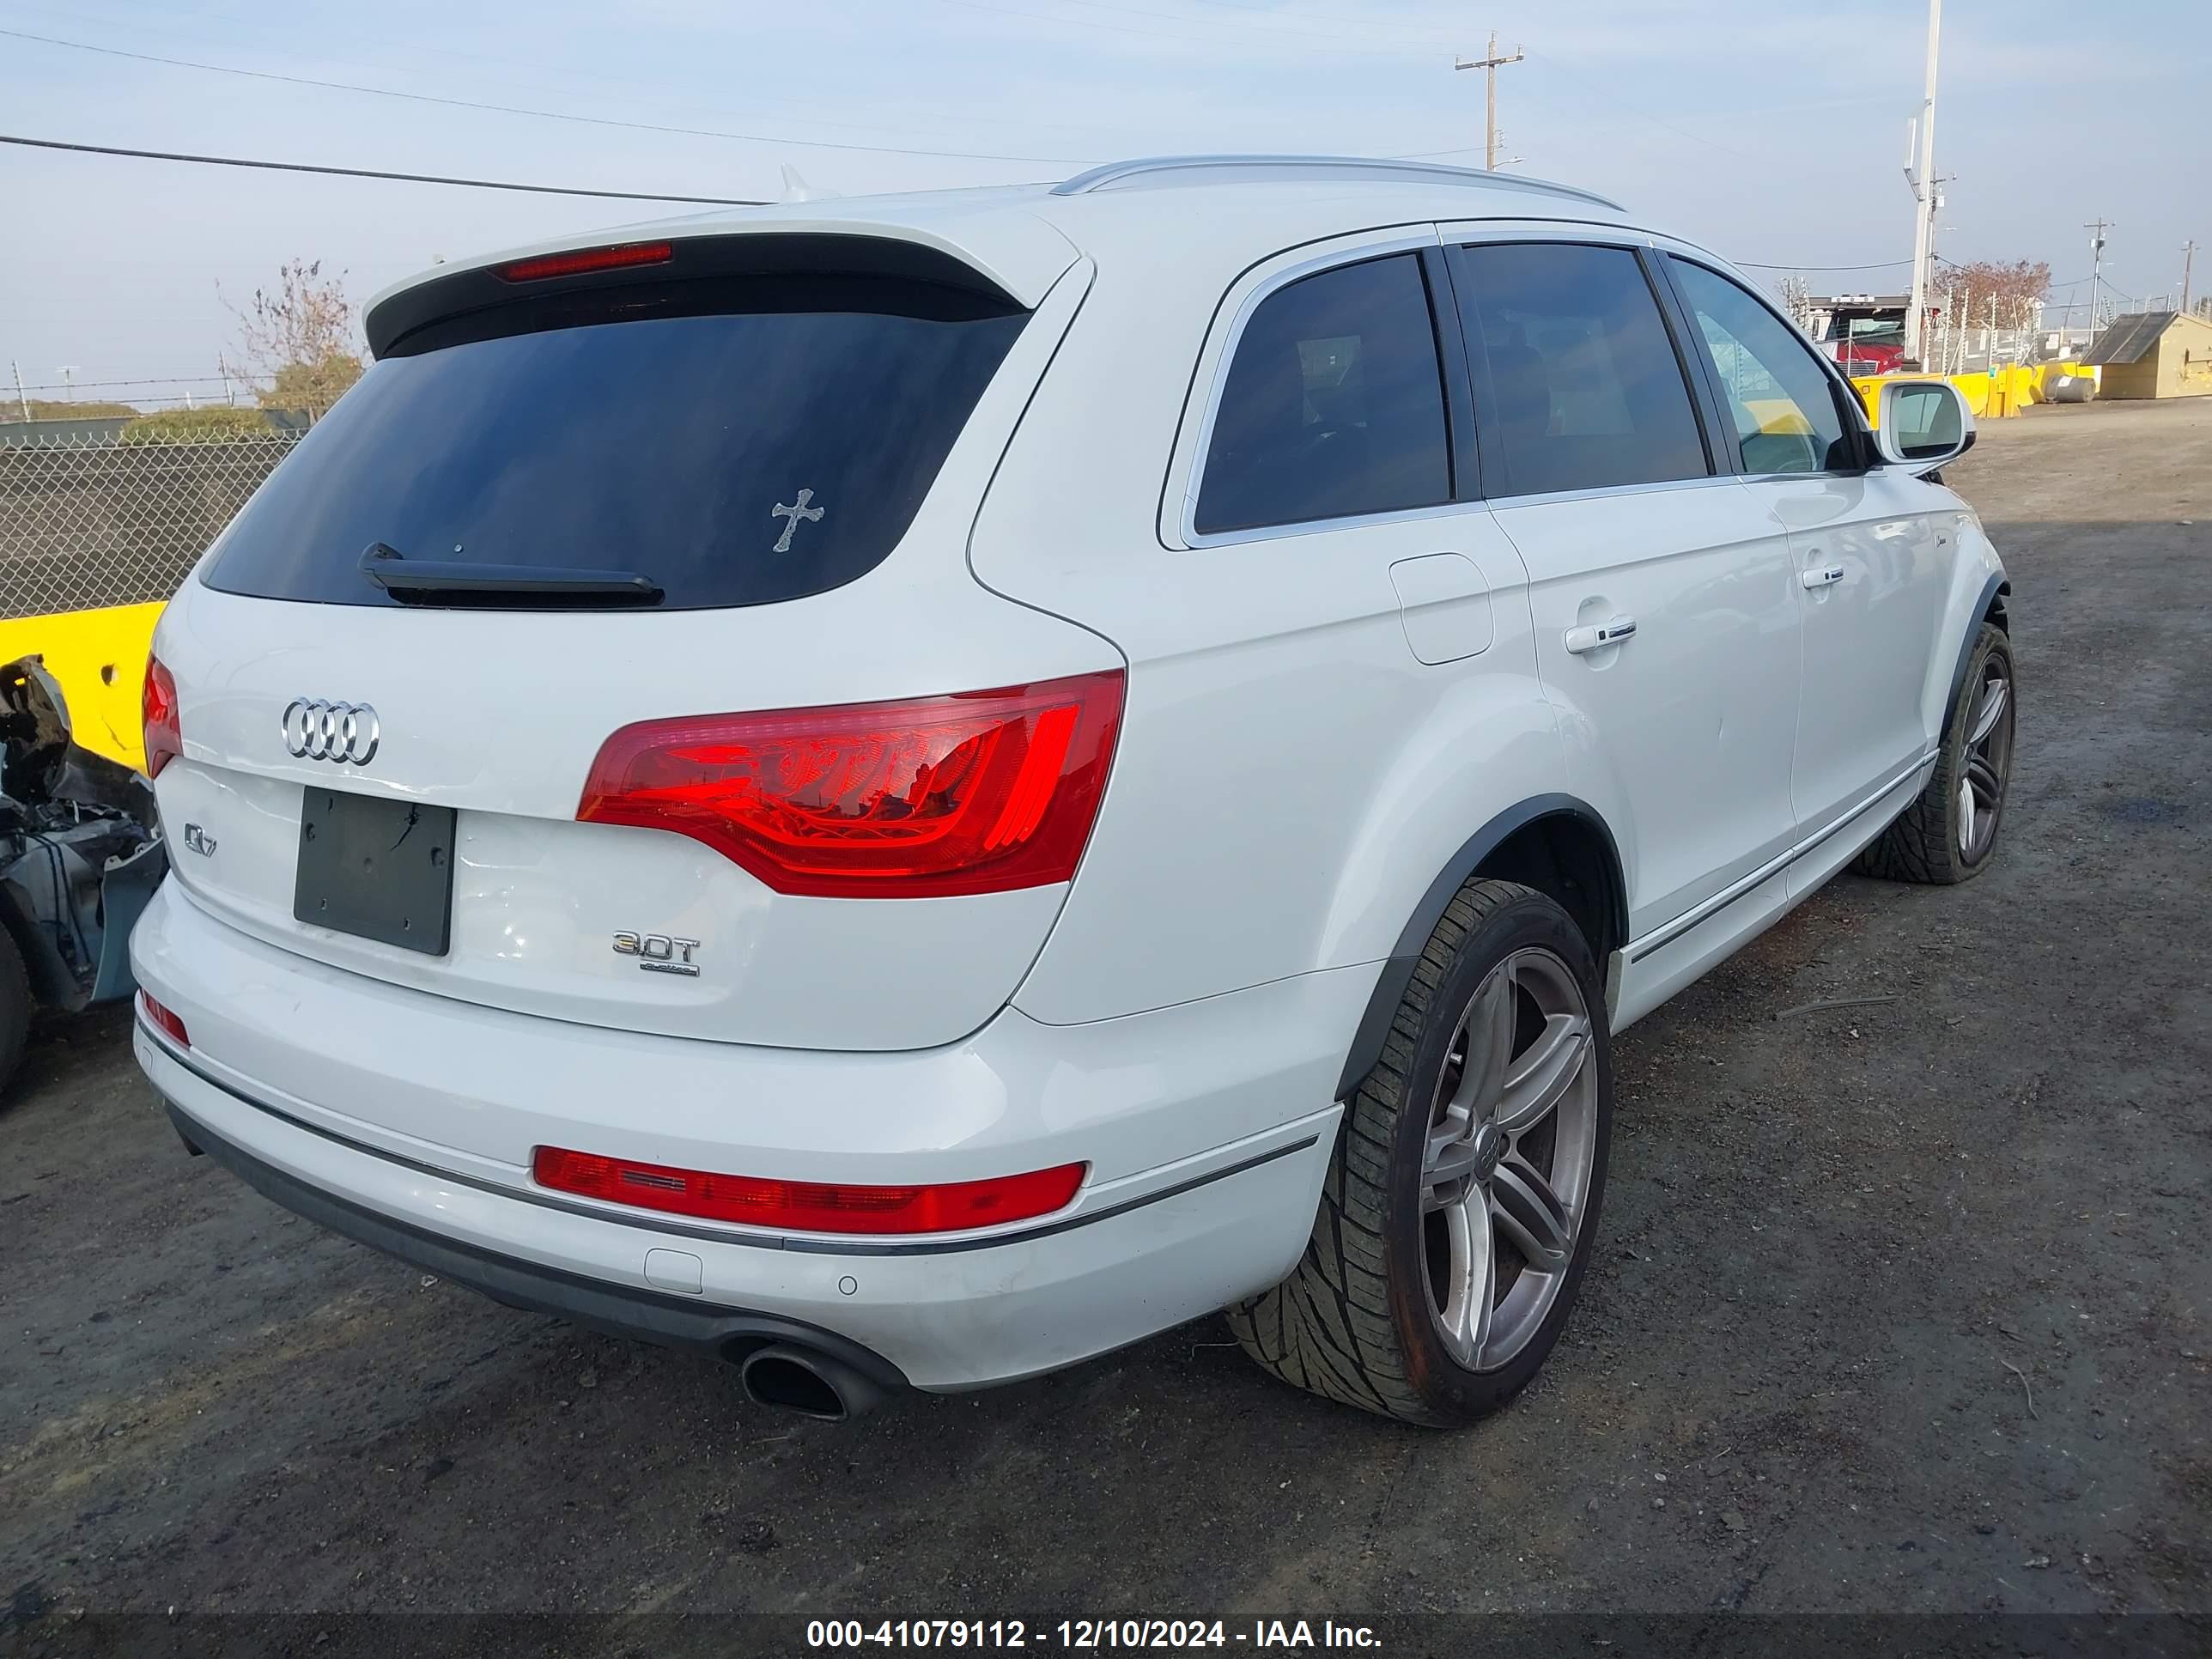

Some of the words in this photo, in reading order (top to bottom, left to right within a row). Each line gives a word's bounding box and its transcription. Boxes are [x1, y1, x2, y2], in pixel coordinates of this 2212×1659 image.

[185, 823, 217, 858] Q7
[612, 930, 700, 963] 3.0T
[643, 961, 694, 975] quattro
